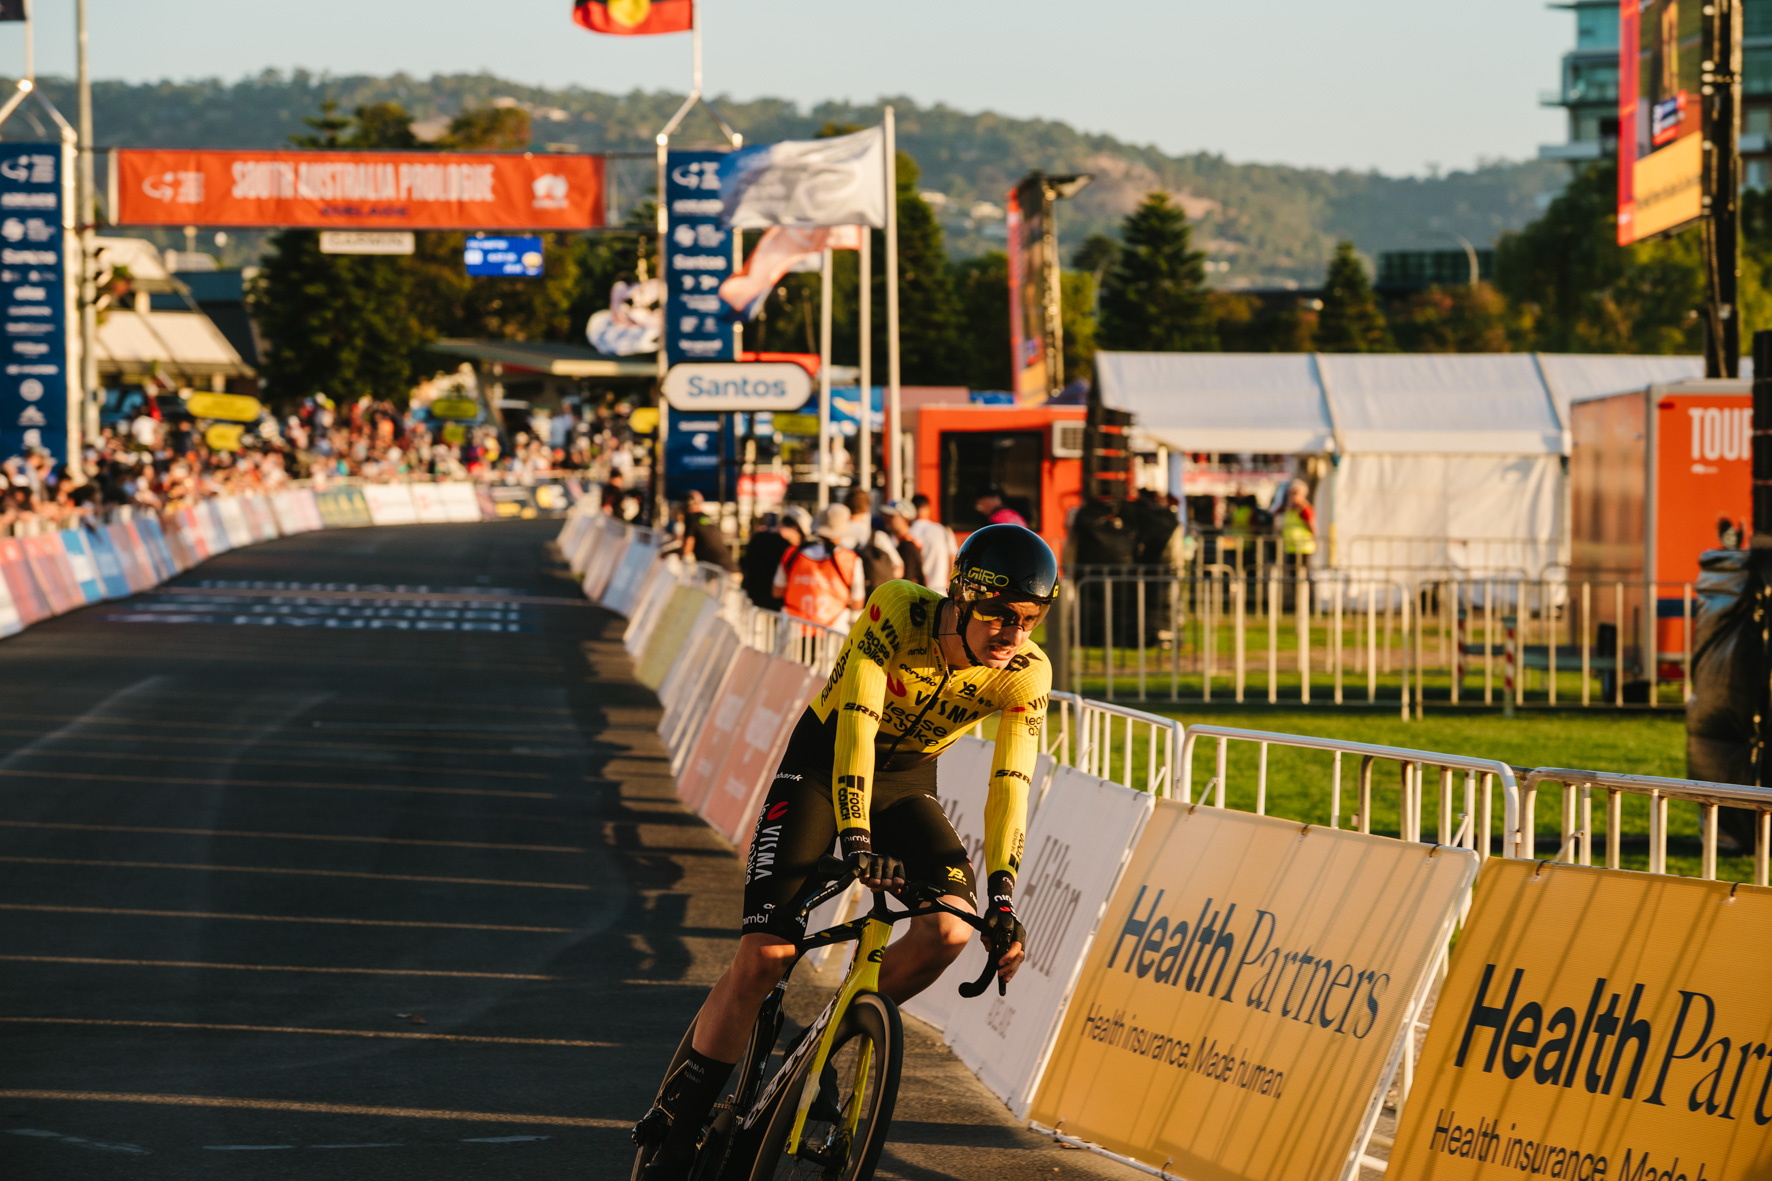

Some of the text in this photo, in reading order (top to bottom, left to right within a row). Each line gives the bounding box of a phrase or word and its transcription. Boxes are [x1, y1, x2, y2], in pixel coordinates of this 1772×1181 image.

[687, 375, 787, 398] Santos
[968, 567, 1009, 587] GIRO
[881, 618, 901, 653] VISM
[843, 702, 881, 724] SRA
[914, 690, 979, 724] VISMA
[994, 769, 1031, 787] SRA
[838, 788, 850, 820] COACH
[849, 792, 861, 819] FOOD
[754, 825, 783, 881] VISMA
[1107, 884, 1391, 1040] Health Partners
[1453, 963, 1652, 1101] Health
[1080, 1001, 1285, 1100] Health insurance. Made human.
[1429, 1108, 1502, 1164] Health
[1617, 1148, 1688, 1181] Md
